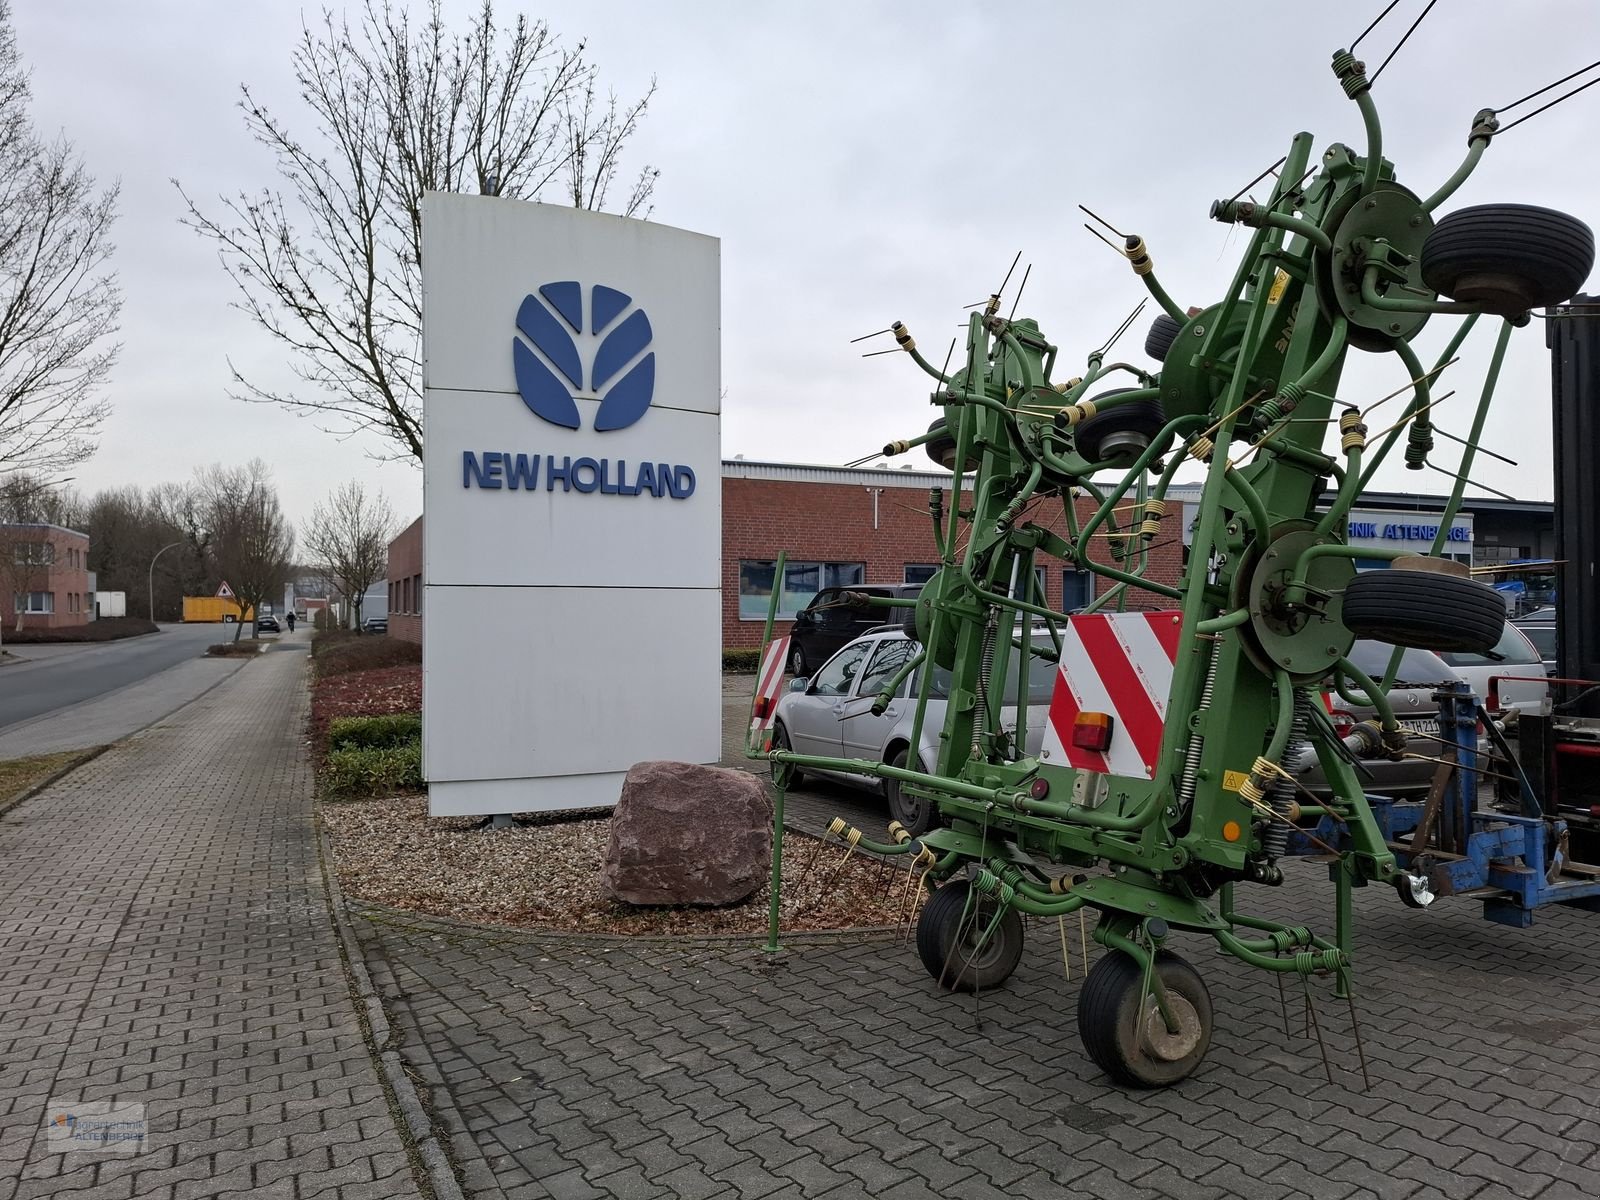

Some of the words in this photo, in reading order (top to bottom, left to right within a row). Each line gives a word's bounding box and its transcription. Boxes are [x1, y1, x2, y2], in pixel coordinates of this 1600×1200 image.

[463, 450, 541, 490] NEW
[546, 454, 696, 499] HOLLAND
[1384, 524, 1471, 541] ALTENBRGE
